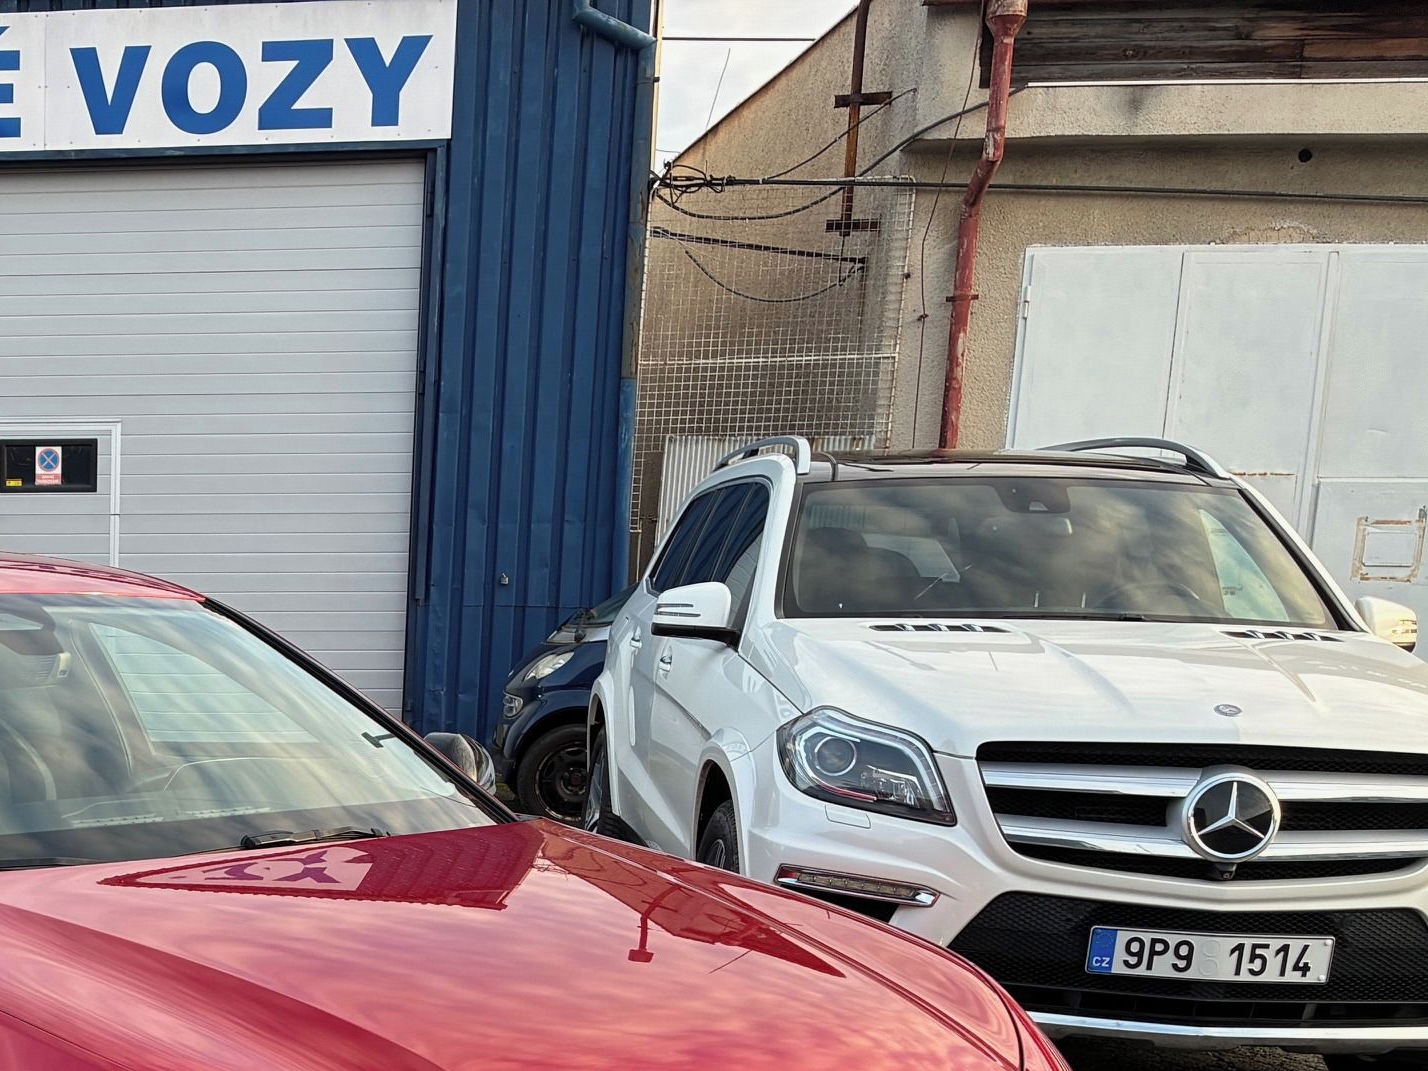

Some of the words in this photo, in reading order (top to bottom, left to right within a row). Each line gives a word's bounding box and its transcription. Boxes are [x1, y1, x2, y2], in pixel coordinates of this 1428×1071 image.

[68, 34, 434, 136] VOZY
[1092, 956, 1110, 968] CZ
[1122, 937, 1195, 973] 9P9
[1229, 942, 1311, 978] 1514
